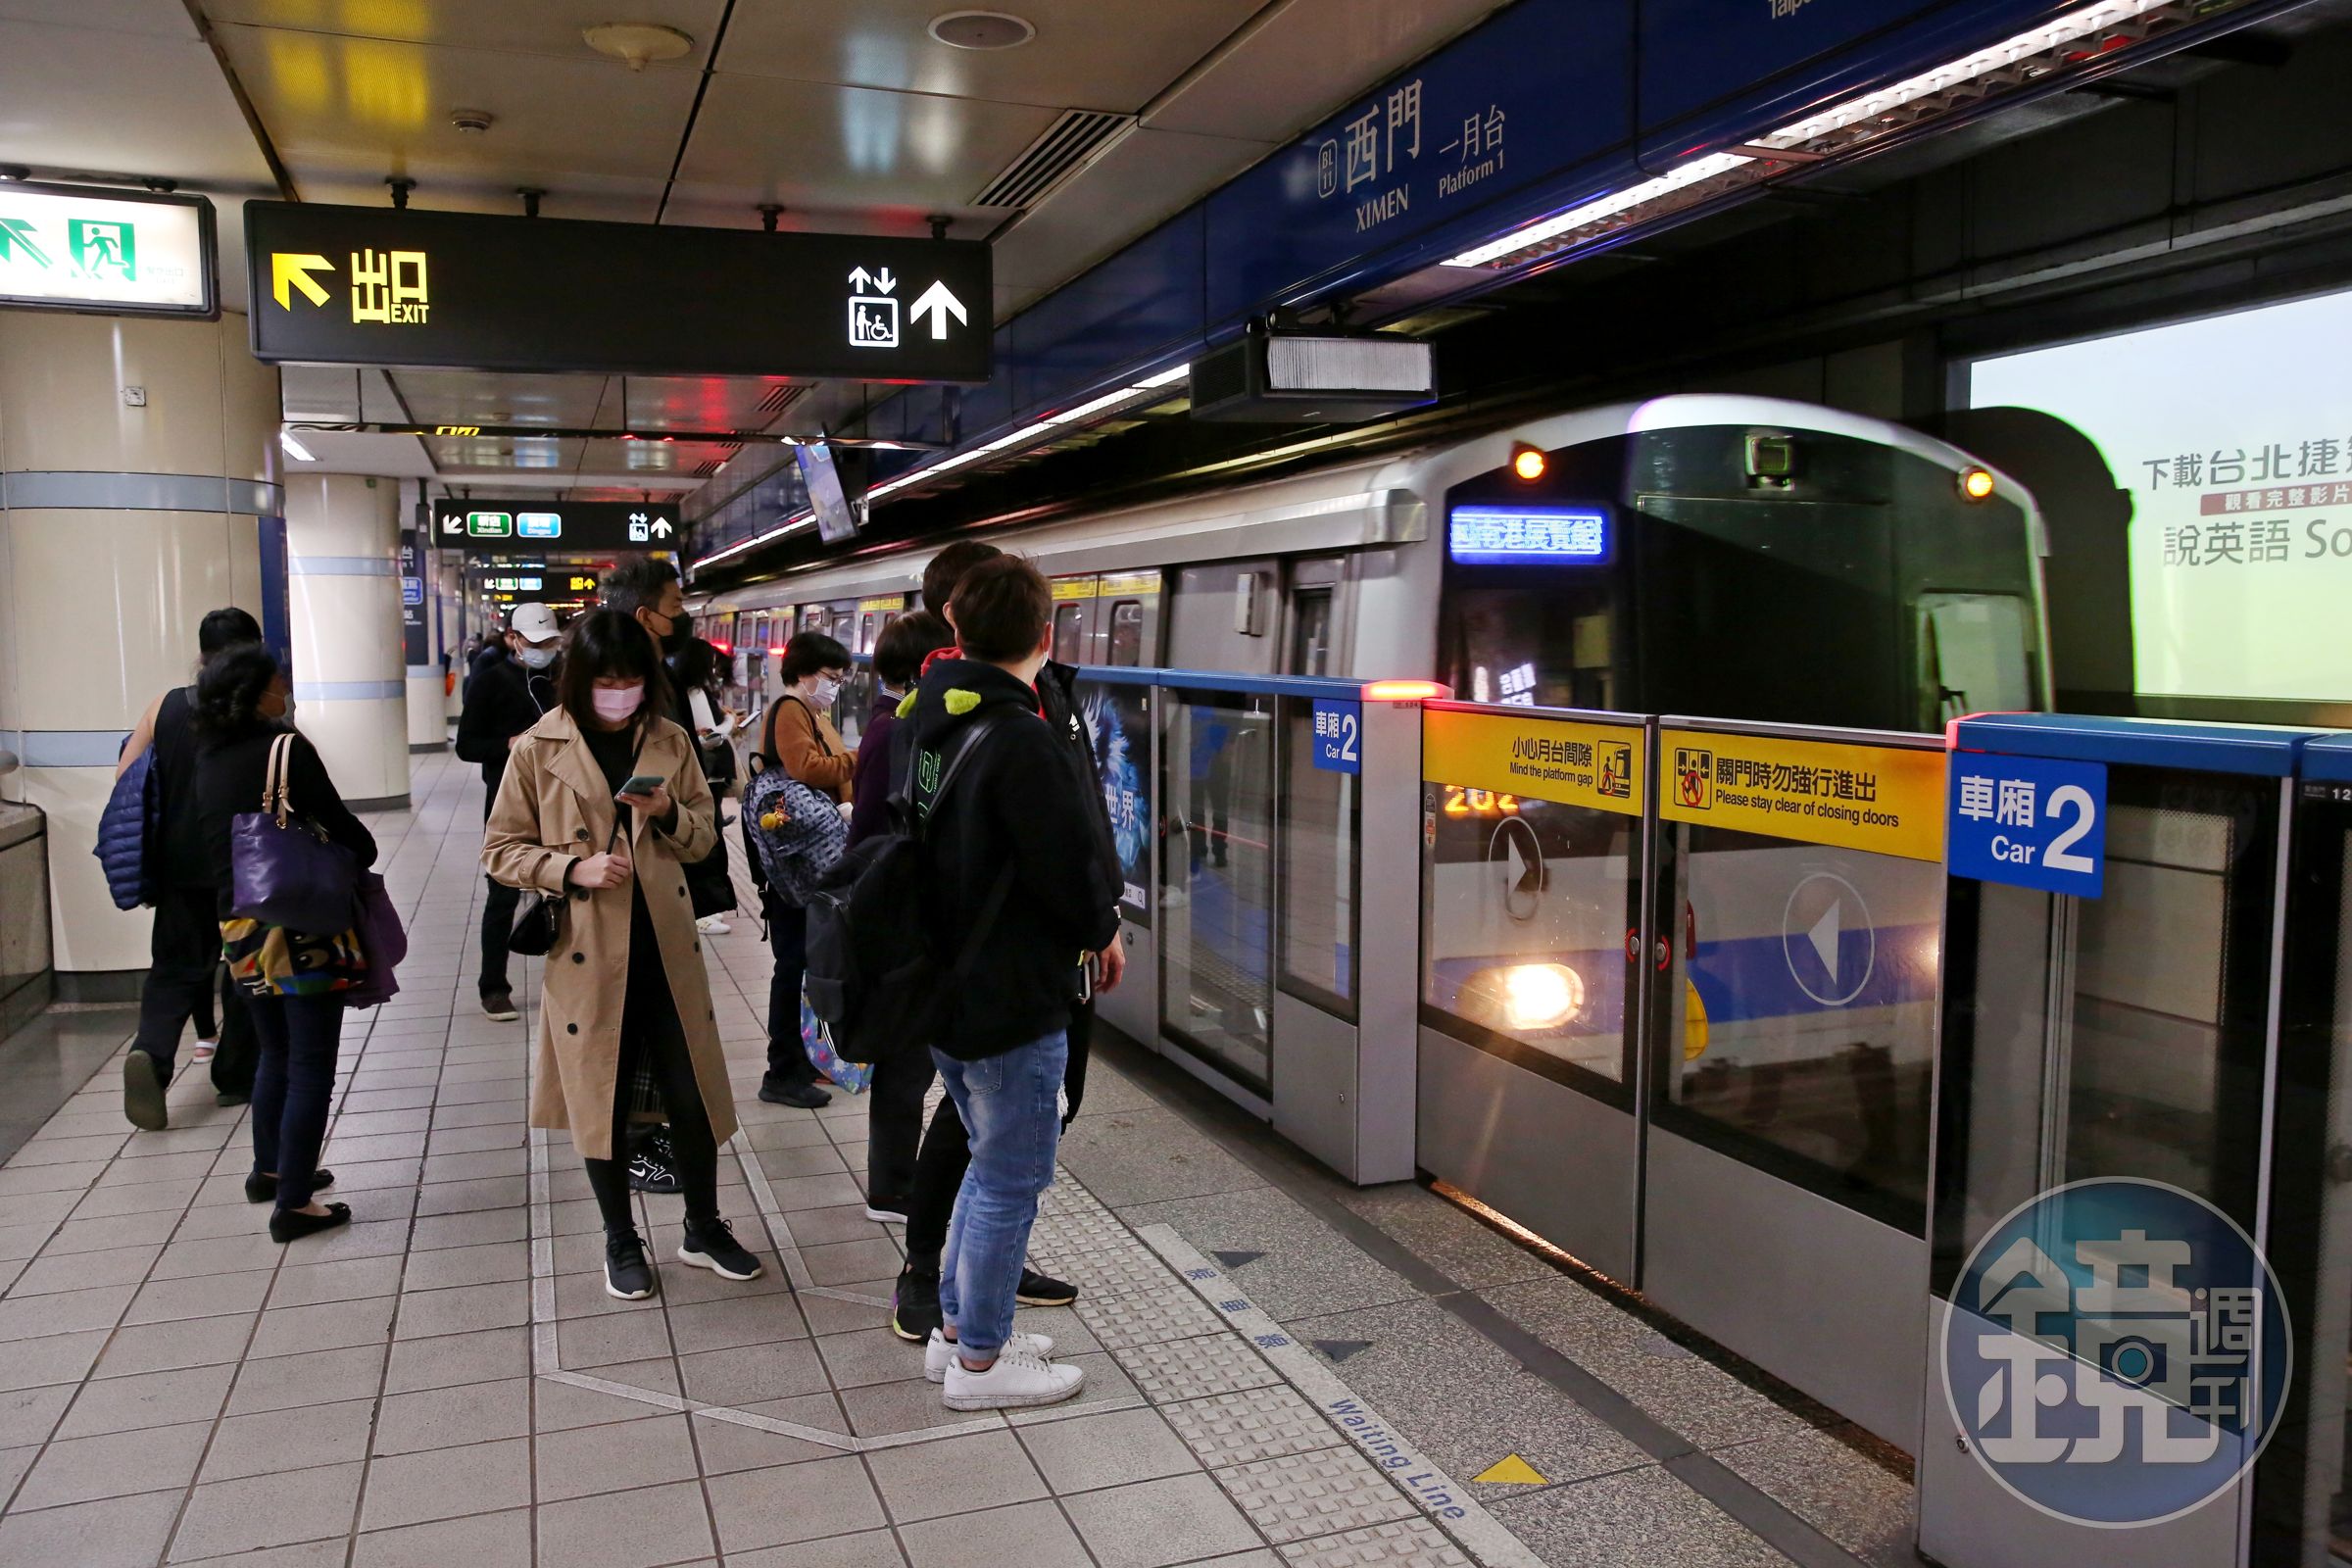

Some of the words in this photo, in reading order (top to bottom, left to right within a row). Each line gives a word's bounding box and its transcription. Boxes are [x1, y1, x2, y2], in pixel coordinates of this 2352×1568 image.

[1345, 78, 1423, 194] 西門
[1439, 104, 1505, 163] 一月台
[1322, 148, 1334, 170] BL
[1439, 160, 1494, 198] Platform
[1496, 149, 1504, 171] 1
[1355, 183, 1409, 233] XIMEN
[351, 248, 428, 324] 出口
[391, 303, 430, 324] EXIT
[2225, 483, 2350, 512] 觀看完整影片
[2163, 519, 2290, 566] 說英語
[1315, 710, 1340, 739] 車廂
[1341, 713, 1357, 762] 2
[1325, 743, 1341, 760] Car
[1512, 737, 1592, 767] 小心月台間隙
[1509, 761, 1528, 777] Mind
[1529, 764, 1543, 778] the
[1543, 766, 1576, 784] platform
[1577, 771, 1593, 788] gap
[1716, 757, 1876, 803] 關門時勿強行進出
[1716, 789, 1749, 806] Please
[1750, 794, 1773, 813] stay
[1775, 797, 1801, 814] clear
[1803, 801, 1816, 816] of
[1818, 803, 1860, 827] closing
[1862, 808, 1899, 827] doors
[1959, 775, 2036, 828] 車廂
[2041, 785, 2096, 874] 2
[1990, 836, 2036, 864] Car
[1329, 1398, 1412, 1469] Waiting
[1406, 1471, 1467, 1520] Line
